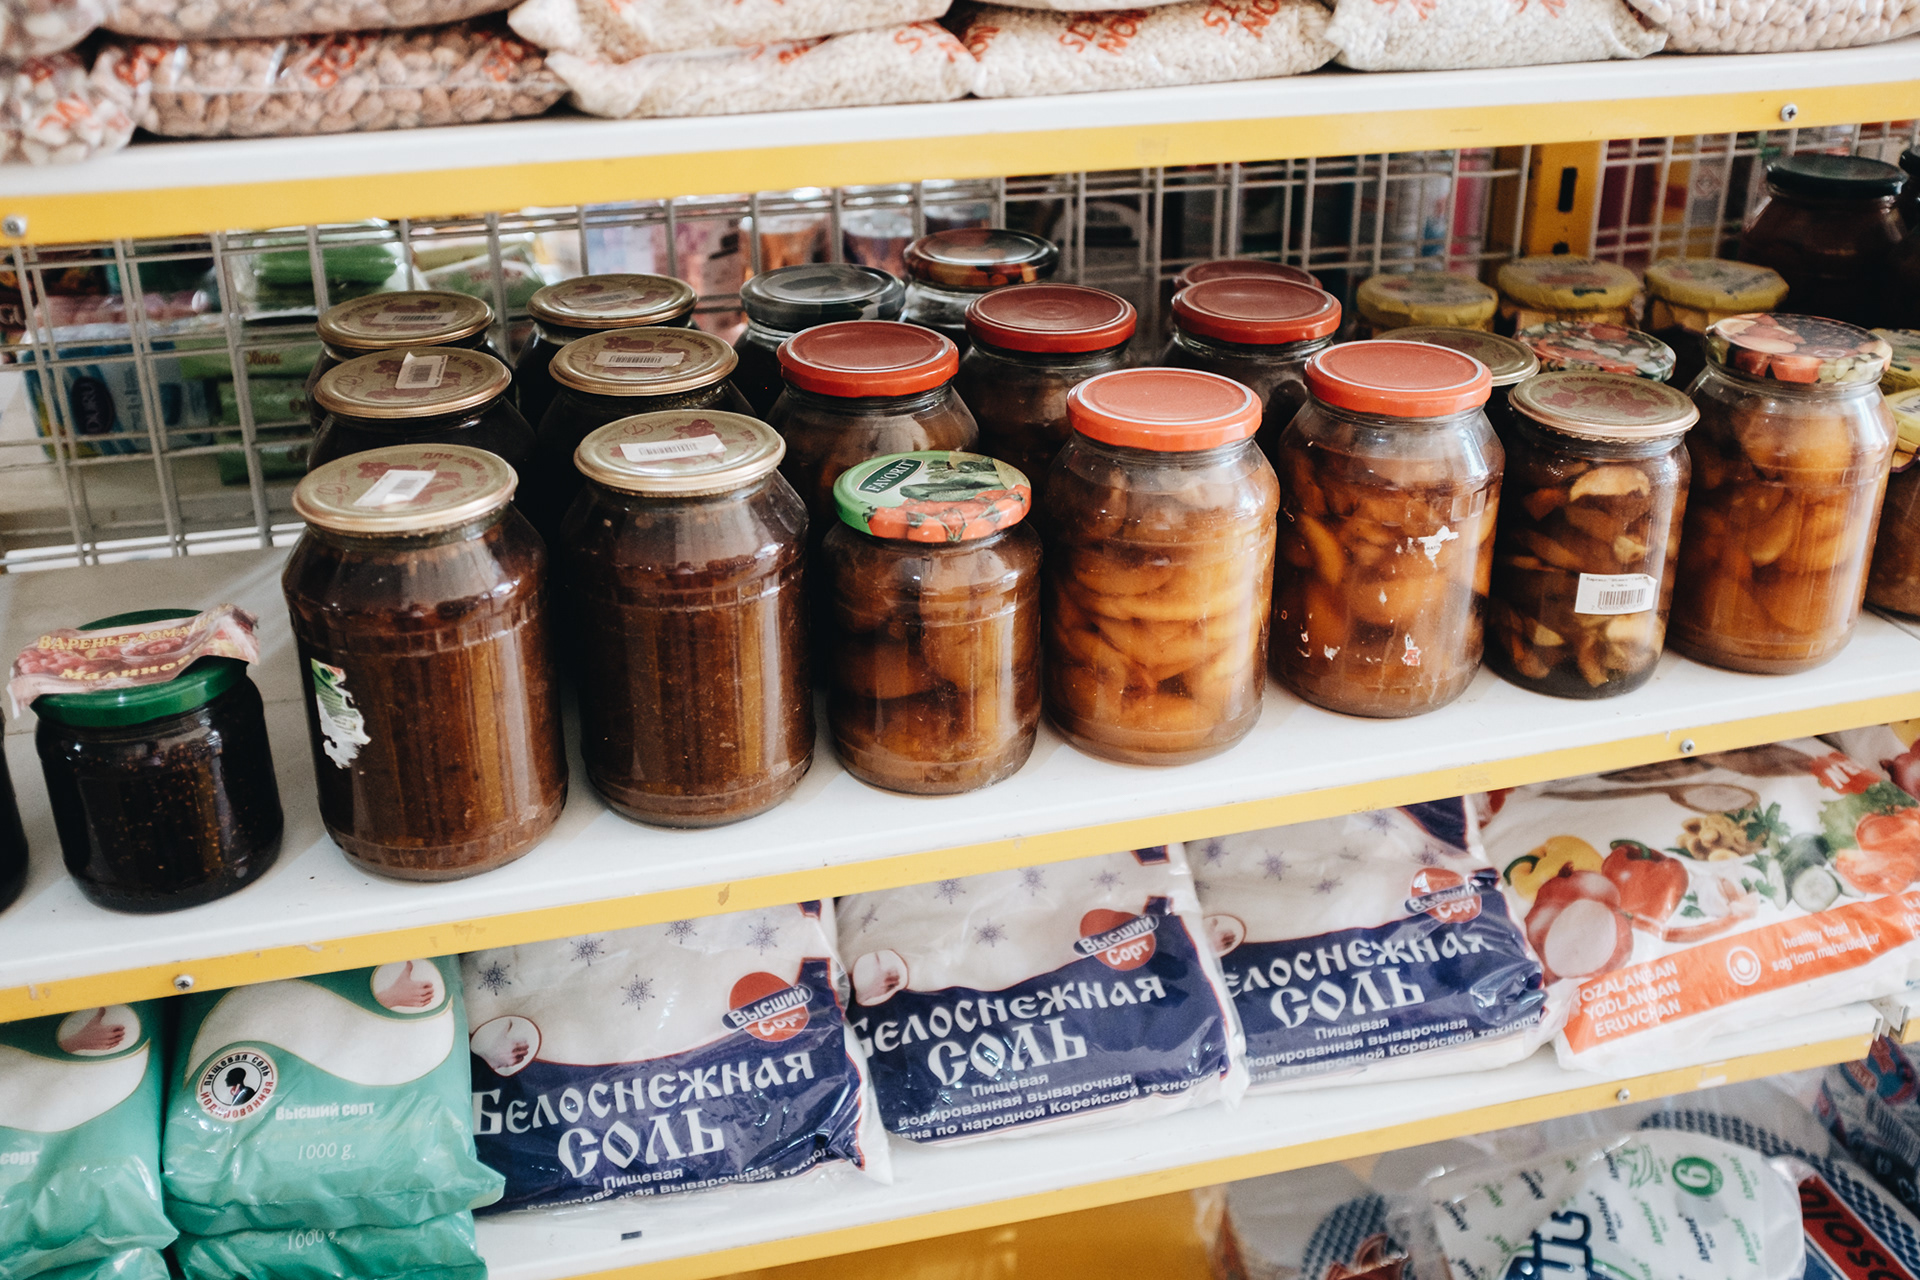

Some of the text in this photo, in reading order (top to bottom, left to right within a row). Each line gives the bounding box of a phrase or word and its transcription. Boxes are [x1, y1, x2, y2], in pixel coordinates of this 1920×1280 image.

[864, 460, 915, 492] FAVORIT
[37, 634, 131, 651] ВАРЕНЬЕ
[1079, 915, 1156, 956] Высший
[1782, 921, 1850, 950] healthy food
[1105, 939, 1151, 967] Сорт
[1225, 930, 1494, 1000] ЕЛОСНЕЖНАЯ
[727, 984, 808, 1028] Высший
[1270, 967, 1425, 1029] СОЛЬ
[757, 1012, 804, 1037] Сорт
[1314, 1017, 1390, 1041] Пищевая
[1367, 1017, 1469, 1047] выварочная
[1594, 998, 1682, 1038] ERUVCHAN
[928, 1016, 1088, 1086] СОЛЬ
[1304, 1048, 1386, 1075] народной
[1389, 1029, 1476, 1057] Корейской
[200, 1081, 275, 1119] Йодрованная
[970, 1073, 1050, 1098] Пищевая
[341, 1101, 376, 1118] сорт
[898, 1074, 1132, 1128] йодированная выварочная
[937, 1123, 958, 1137] по
[961, 1105, 1046, 1133] народной
[1050, 1086, 1139, 1115] Корейской
[0, 1150, 40, 1166] сорт
[297, 1142, 357, 1162] 1000 g.
[557, 1109, 726, 1179] СОЛЬ
[602, 1167, 684, 1191] Пищевая
[659, 1165, 770, 1194] выварочная
[1677, 1163, 1710, 1189] 6
[288, 1228, 325, 1250] 1000
